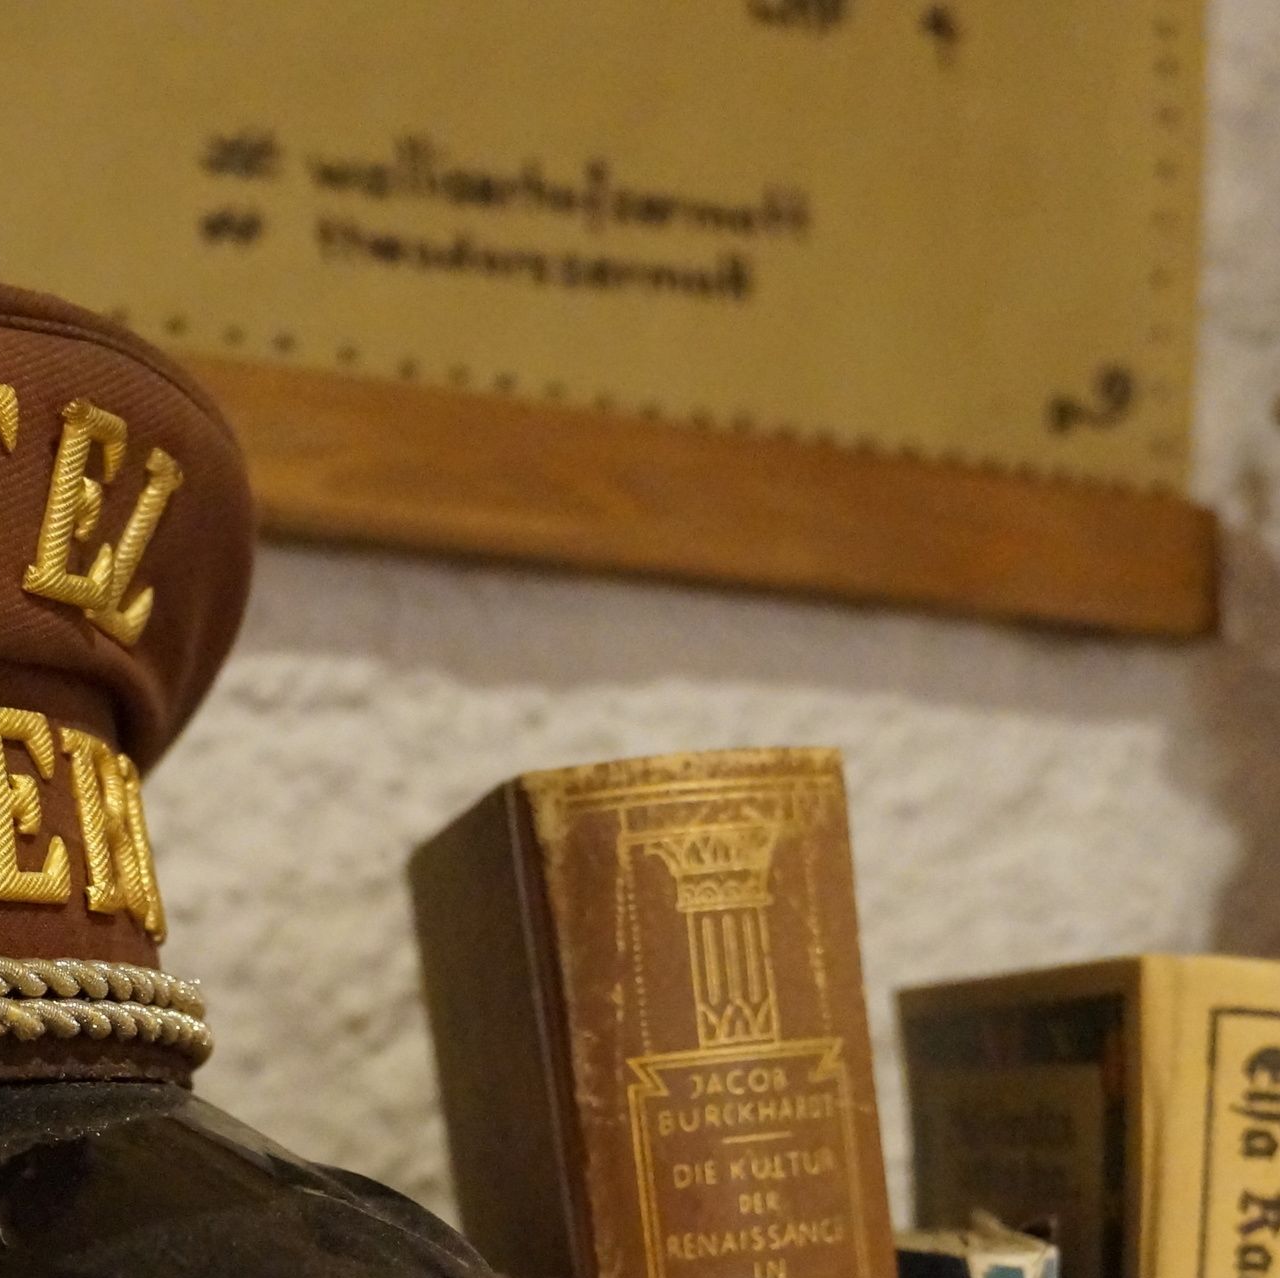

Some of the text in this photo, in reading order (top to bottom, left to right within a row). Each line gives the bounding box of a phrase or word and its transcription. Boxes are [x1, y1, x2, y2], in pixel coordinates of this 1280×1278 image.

[689, 1066, 788, 1099] JACOB
[673, 1147, 837, 1189] DIE KULTUR
[738, 1190, 780, 1215] DER
